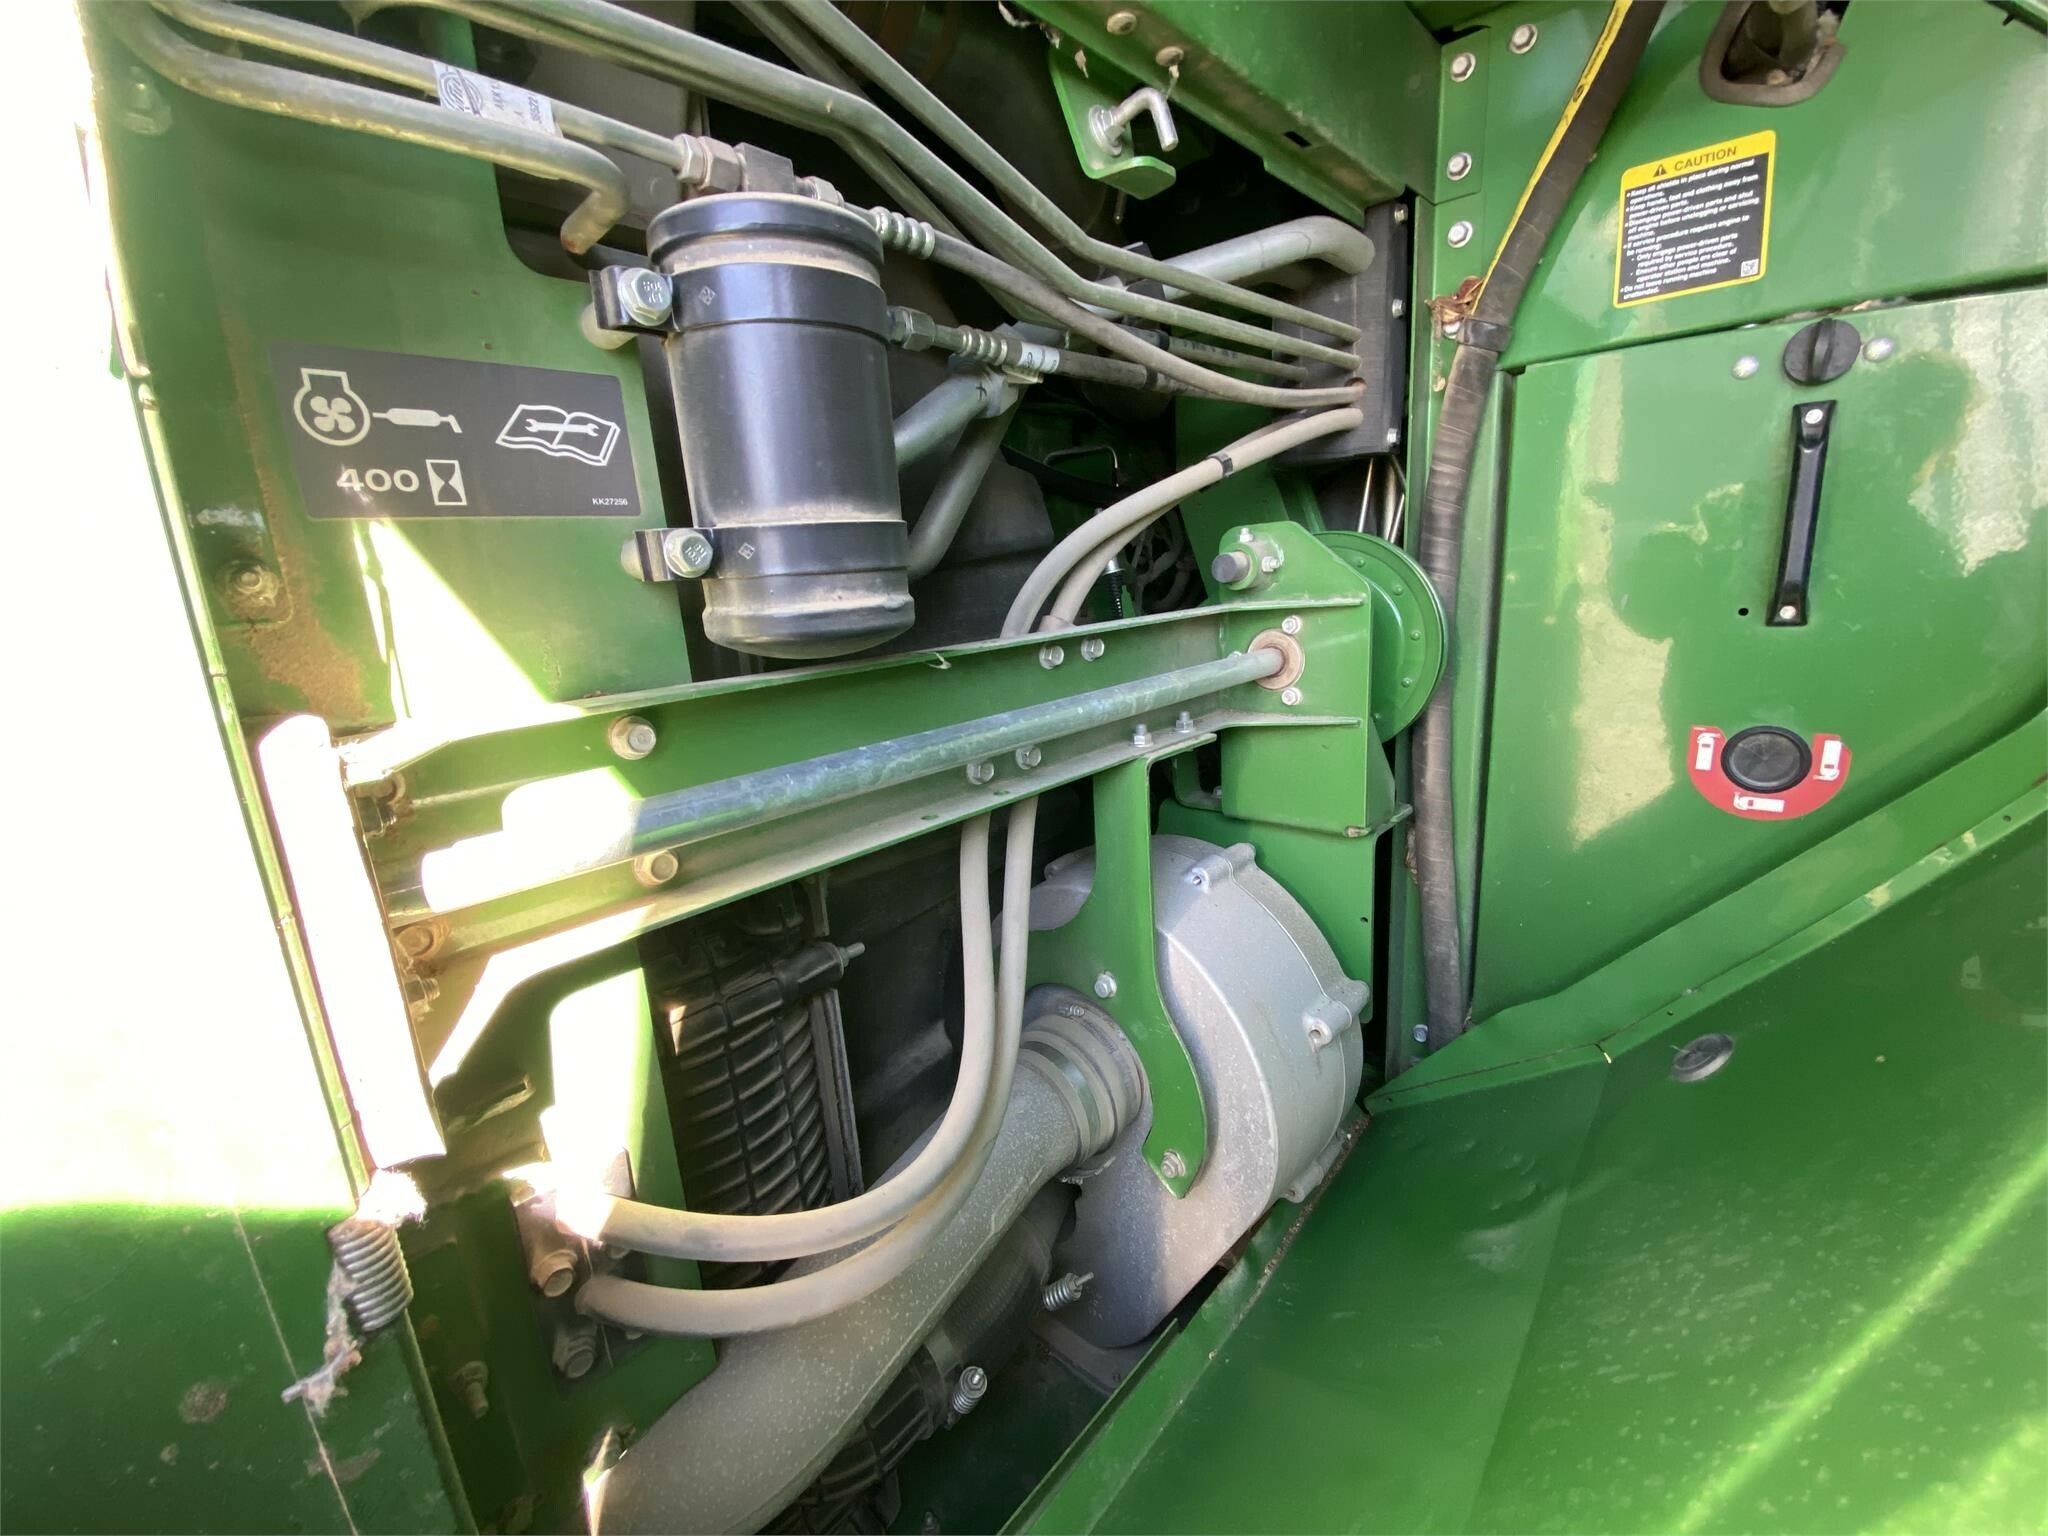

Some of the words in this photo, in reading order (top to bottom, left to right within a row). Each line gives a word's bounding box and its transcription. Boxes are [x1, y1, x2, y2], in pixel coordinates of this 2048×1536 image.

[1675, 147, 1736, 170] CAUTION
[1630, 188, 1647, 197] Keep
[1657, 179, 1680, 190] shields
[1688, 172, 1706, 181] place
[1707, 166, 1729, 176] during
[1730, 159, 1754, 169] normal
[1630, 203, 1646, 212] Keep
[1696, 183, 1722, 195] clothing
[1724, 178, 1741, 188] away
[1742, 174, 1758, 183] from
[1629, 214, 1661, 227] Disengage
[1662, 203, 1704, 219] power-driven
[1705, 198, 1722, 208] parts
[1738, 190, 1753, 199] shut
[1629, 204, 1669, 220] power-driven
[1638, 222, 1658, 232] engine
[1660, 216, 1680, 226] before
[1681, 207, 1718, 221] unclogging
[1728, 197, 1759, 210] servicing
[1633, 237, 1655, 248] service
[1656, 229, 1688, 242] procedure
[1690, 222, 1717, 234] requires
[1718, 217, 1741, 227] engine
[1637, 253, 1651, 261] Only
[1652, 247, 1676, 258] engage
[1677, 237, 1719, 252] power-driven
[1720, 233, 1738, 242] parts
[1637, 257, 1664, 268] required
[1674, 250, 1697, 260] service
[1635, 266, 1658, 276] Ensure
[1659, 261, 1676, 270] other
[1676, 257, 1699, 267] people
[1712, 250, 1728, 259] clear
[1636, 272, 1663, 282] operator
[1664, 267, 1686, 276] station
[1645, 279, 1662, 288] leave
[1663, 274, 1688, 284] running
[1689, 268, 1717, 278] machine
[336, 468, 420, 492] 400
[592, 497, 628, 506] KK27256
